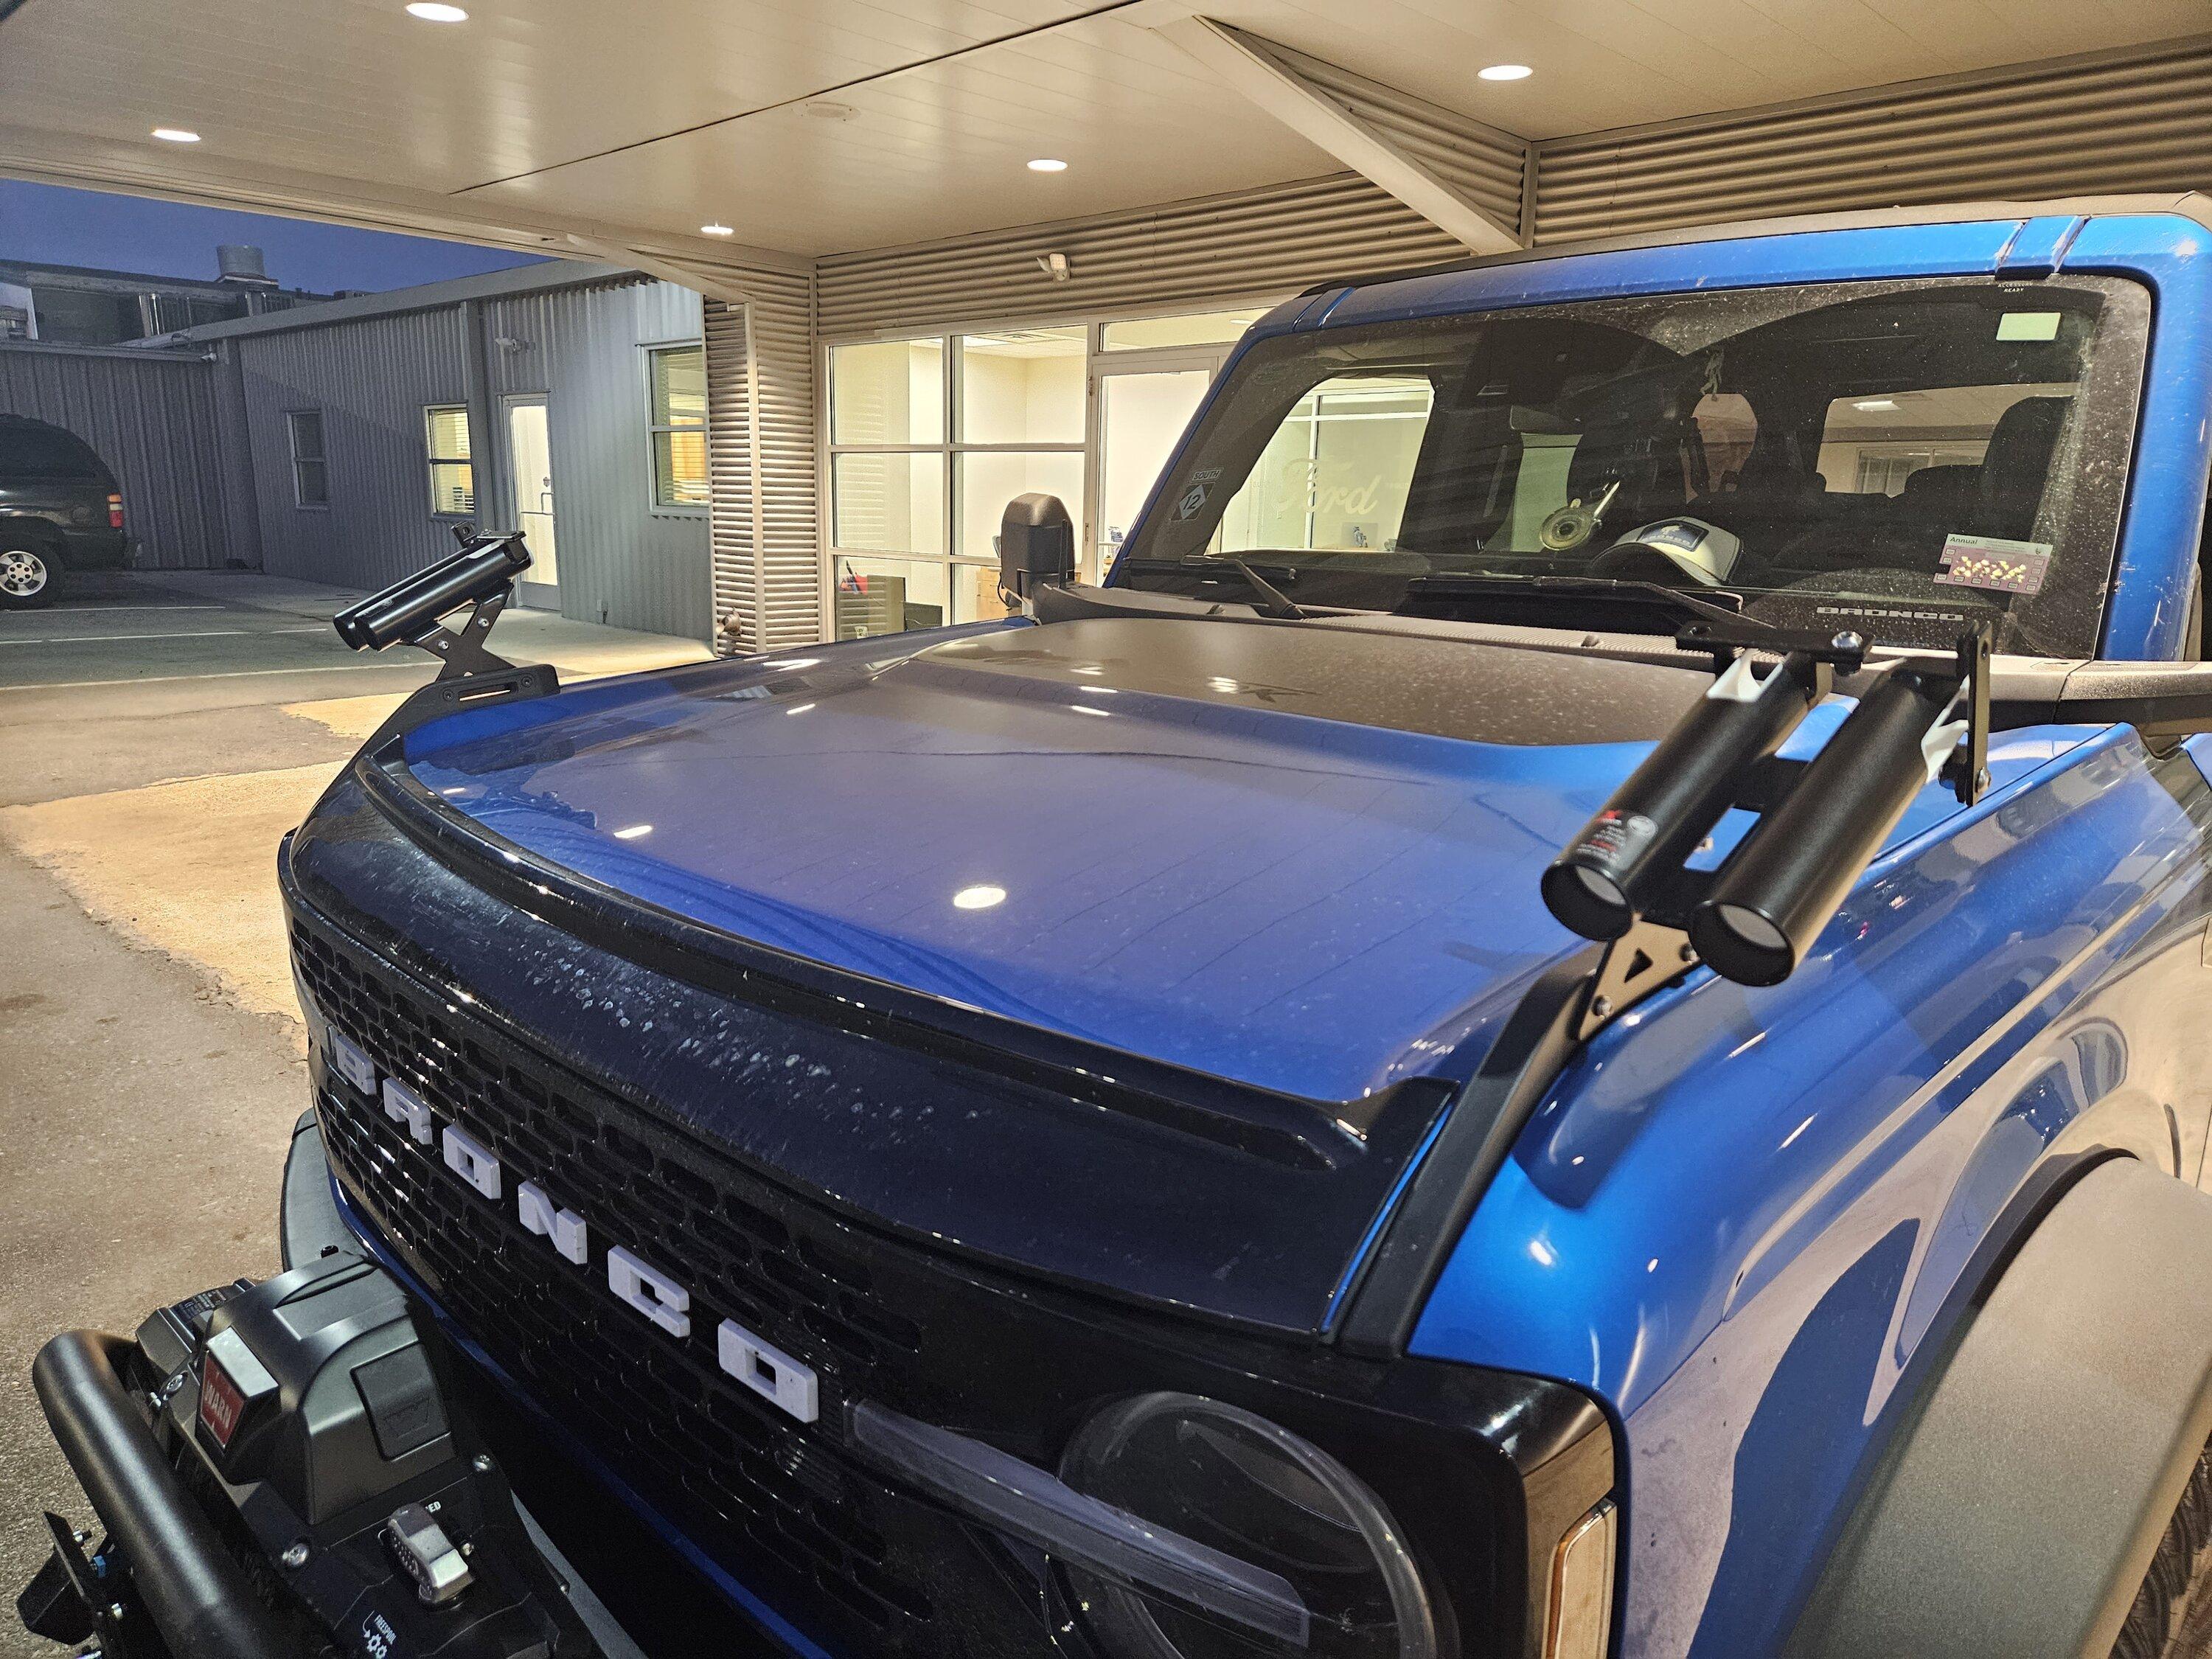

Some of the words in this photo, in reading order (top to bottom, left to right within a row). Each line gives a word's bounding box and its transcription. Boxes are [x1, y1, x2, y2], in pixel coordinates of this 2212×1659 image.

[1193, 470, 1221, 480] SOUTH
[1272, 456, 1382, 515] Ford
[1183, 494, 1201, 510] 12
[1950, 536, 1978, 545] Annual
[1816, 606, 1964, 621] BRONCO
[336, 1035, 819, 1424] BRONCO
[204, 1380, 233, 1429] WARN
[374, 1614, 397, 1645] FREESPOOL
